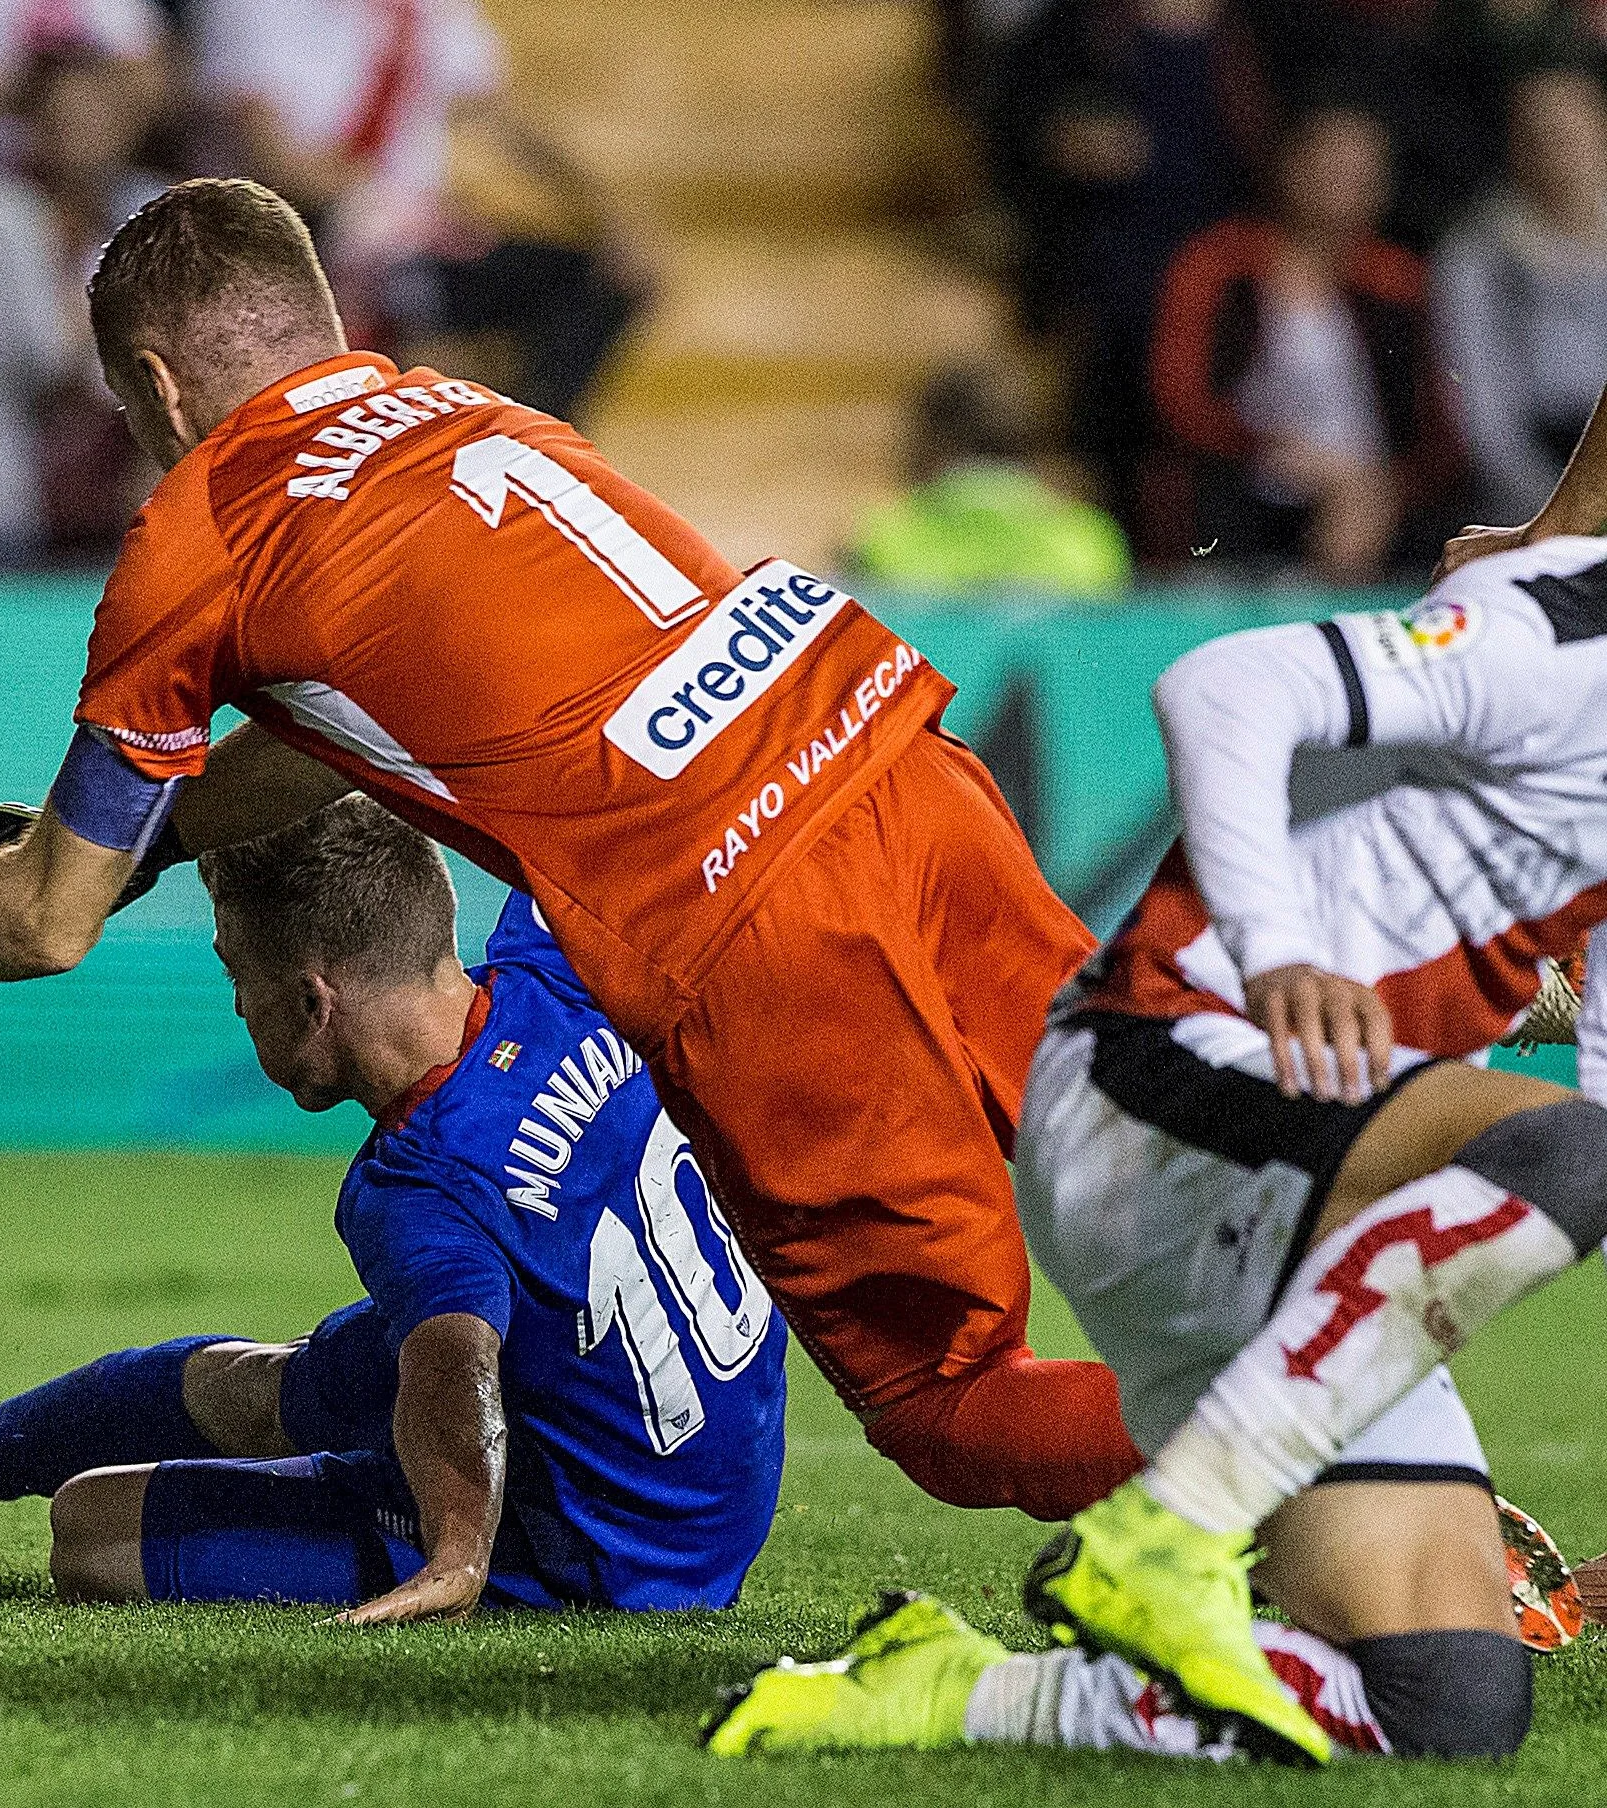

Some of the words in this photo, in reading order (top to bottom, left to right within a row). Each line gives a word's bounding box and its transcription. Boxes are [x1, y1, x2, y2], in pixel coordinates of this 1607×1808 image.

[286, 380, 493, 501] ALBERTO
[449, 433, 710, 630] 1
[700, 781, 784, 894] RAYO
[576, 1106, 773, 1457] 10
